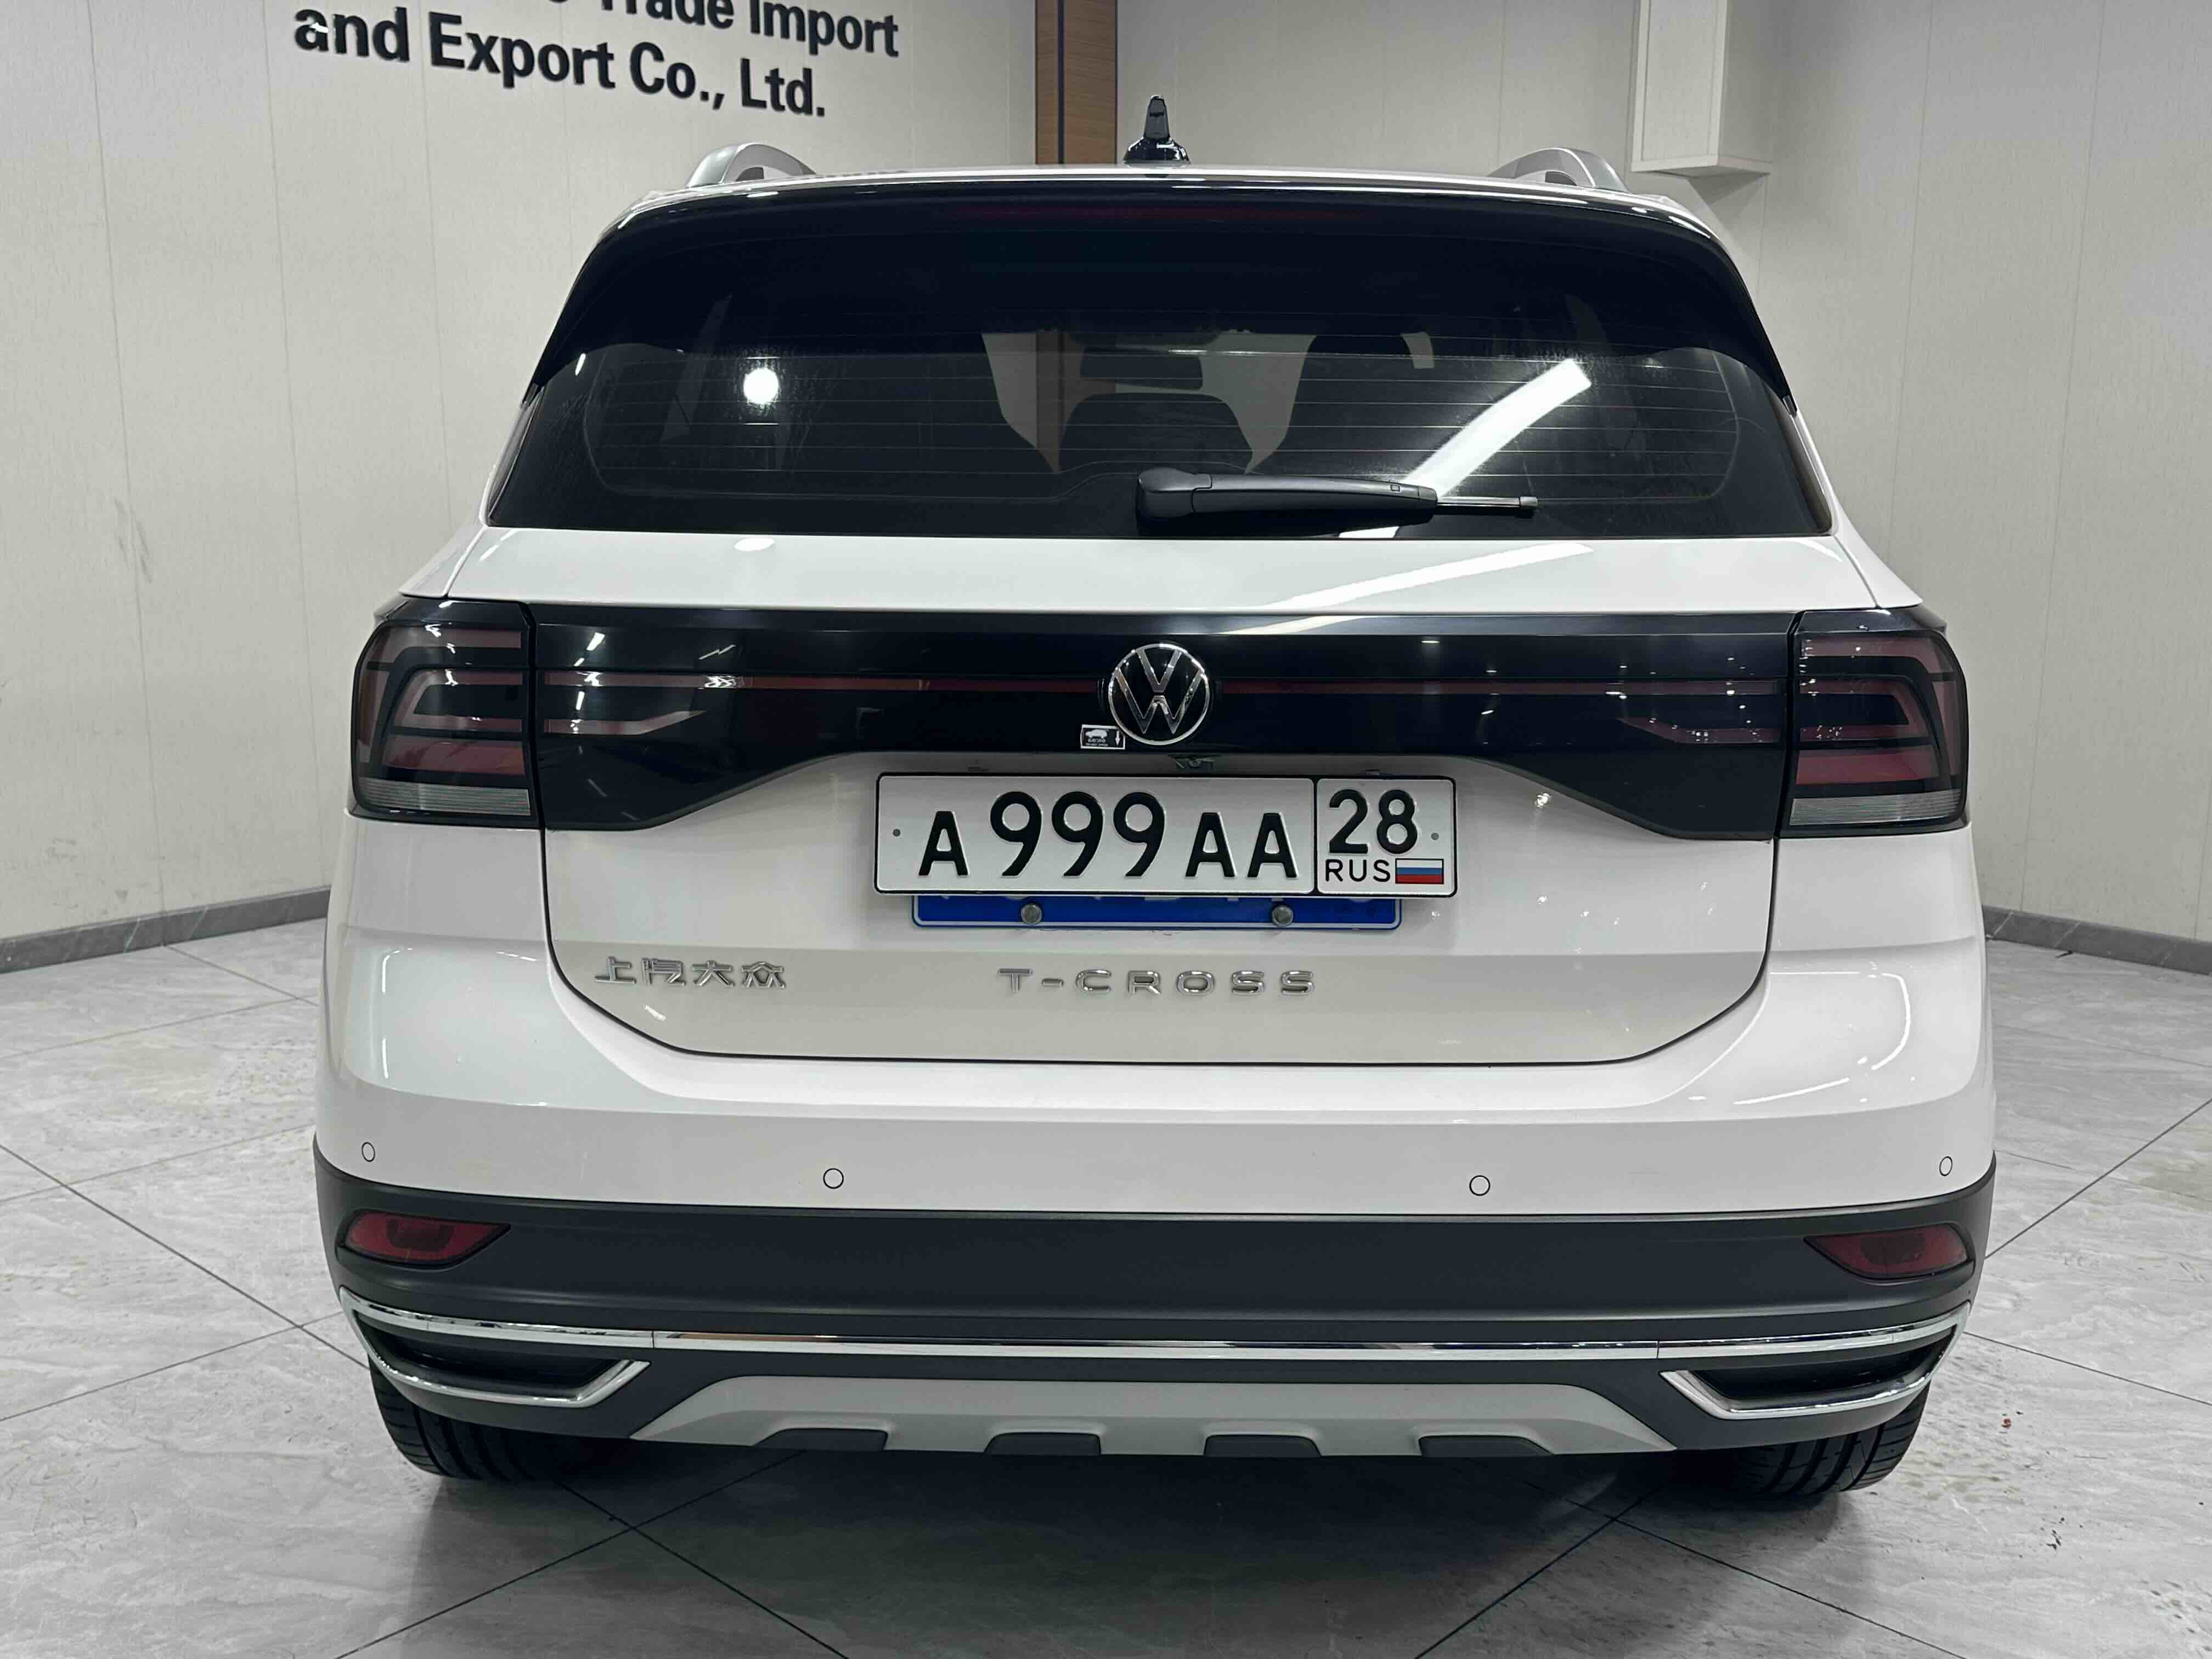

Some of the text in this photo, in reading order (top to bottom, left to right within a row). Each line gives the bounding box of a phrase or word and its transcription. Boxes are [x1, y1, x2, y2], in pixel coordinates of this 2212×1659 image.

[602, 0, 899, 58] ade Import
[295, 7, 825, 117] and Export Co., Ltd.
[1329, 788, 1418, 854] 28
[1325, 859, 1391, 882] RUS
[997, 968, 1316, 996] T-CROSS
